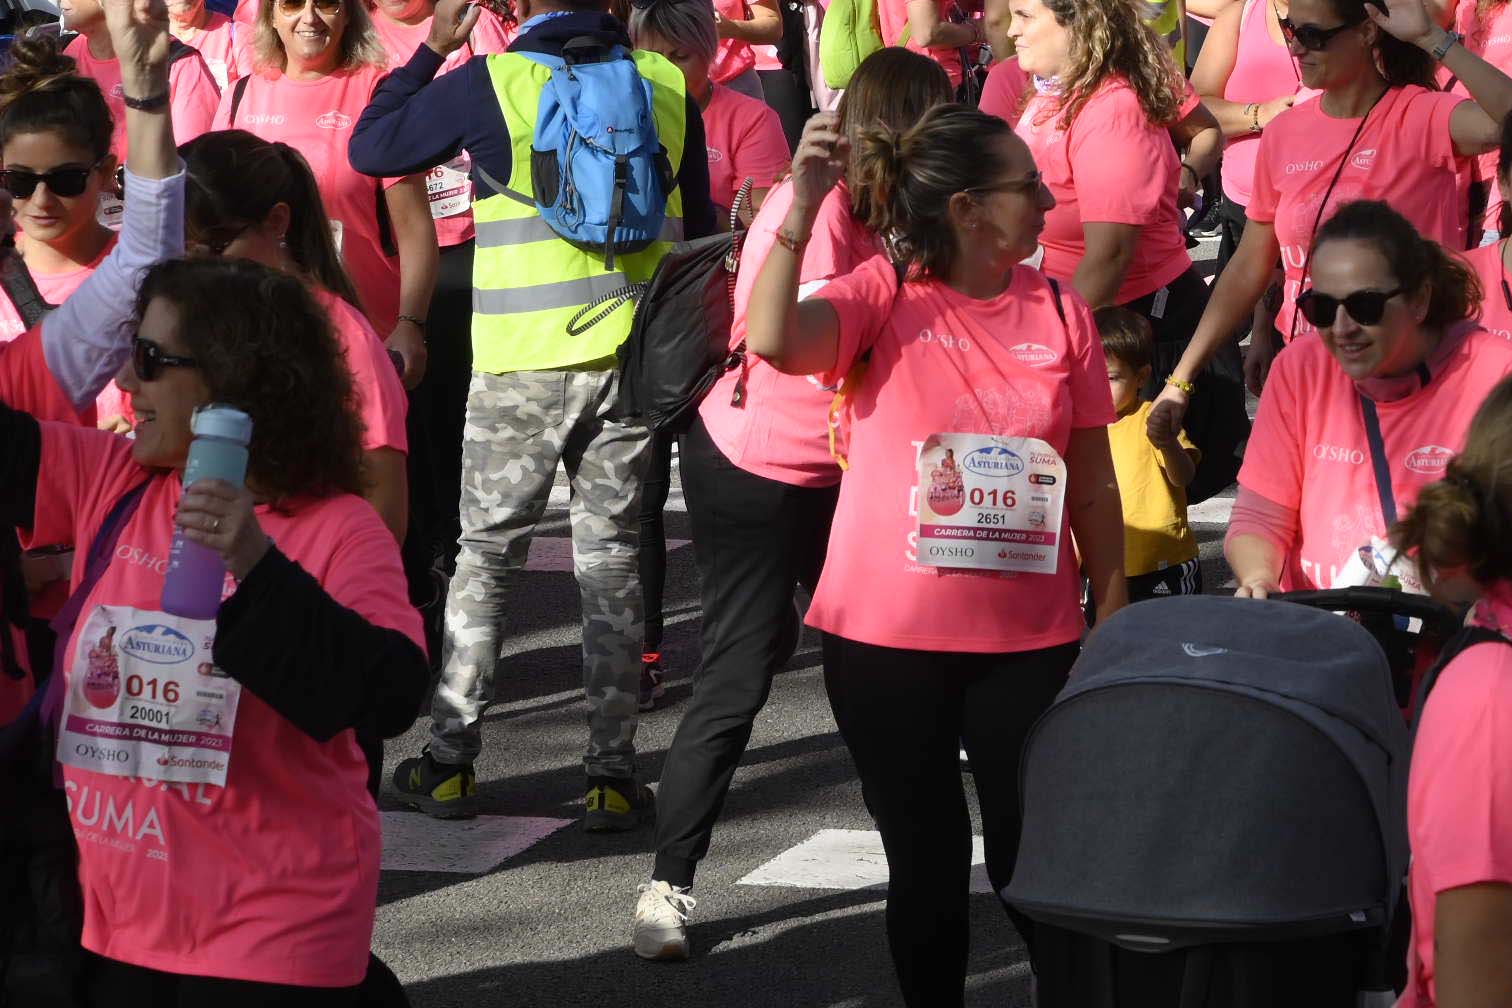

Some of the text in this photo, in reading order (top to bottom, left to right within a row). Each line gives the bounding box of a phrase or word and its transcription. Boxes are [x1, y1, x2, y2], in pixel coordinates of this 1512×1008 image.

[968, 457, 1020, 472] ASTURIANA
[1029, 455, 1057, 466] SUMA
[969, 487, 1017, 508] 016
[976, 512, 1006, 525] 2651
[934, 528, 975, 538] CARRERA
[976, 530, 988, 539] DE
[989, 531, 1000, 539] LA
[929, 545, 975, 559] OYSHO
[1008, 550, 1046, 562] Santander
[125, 635, 188, 658] ASTURIANA
[125, 674, 181, 704] 016
[129, 705, 171, 725] 20001
[86, 723, 130, 737] CARRERA
[133, 727, 147, 738] DE
[147, 729, 160, 740] LA
[160, 731, 196, 743] MUJER
[75, 743, 129, 763] OYSHO
[170, 756, 225, 772] Santander
